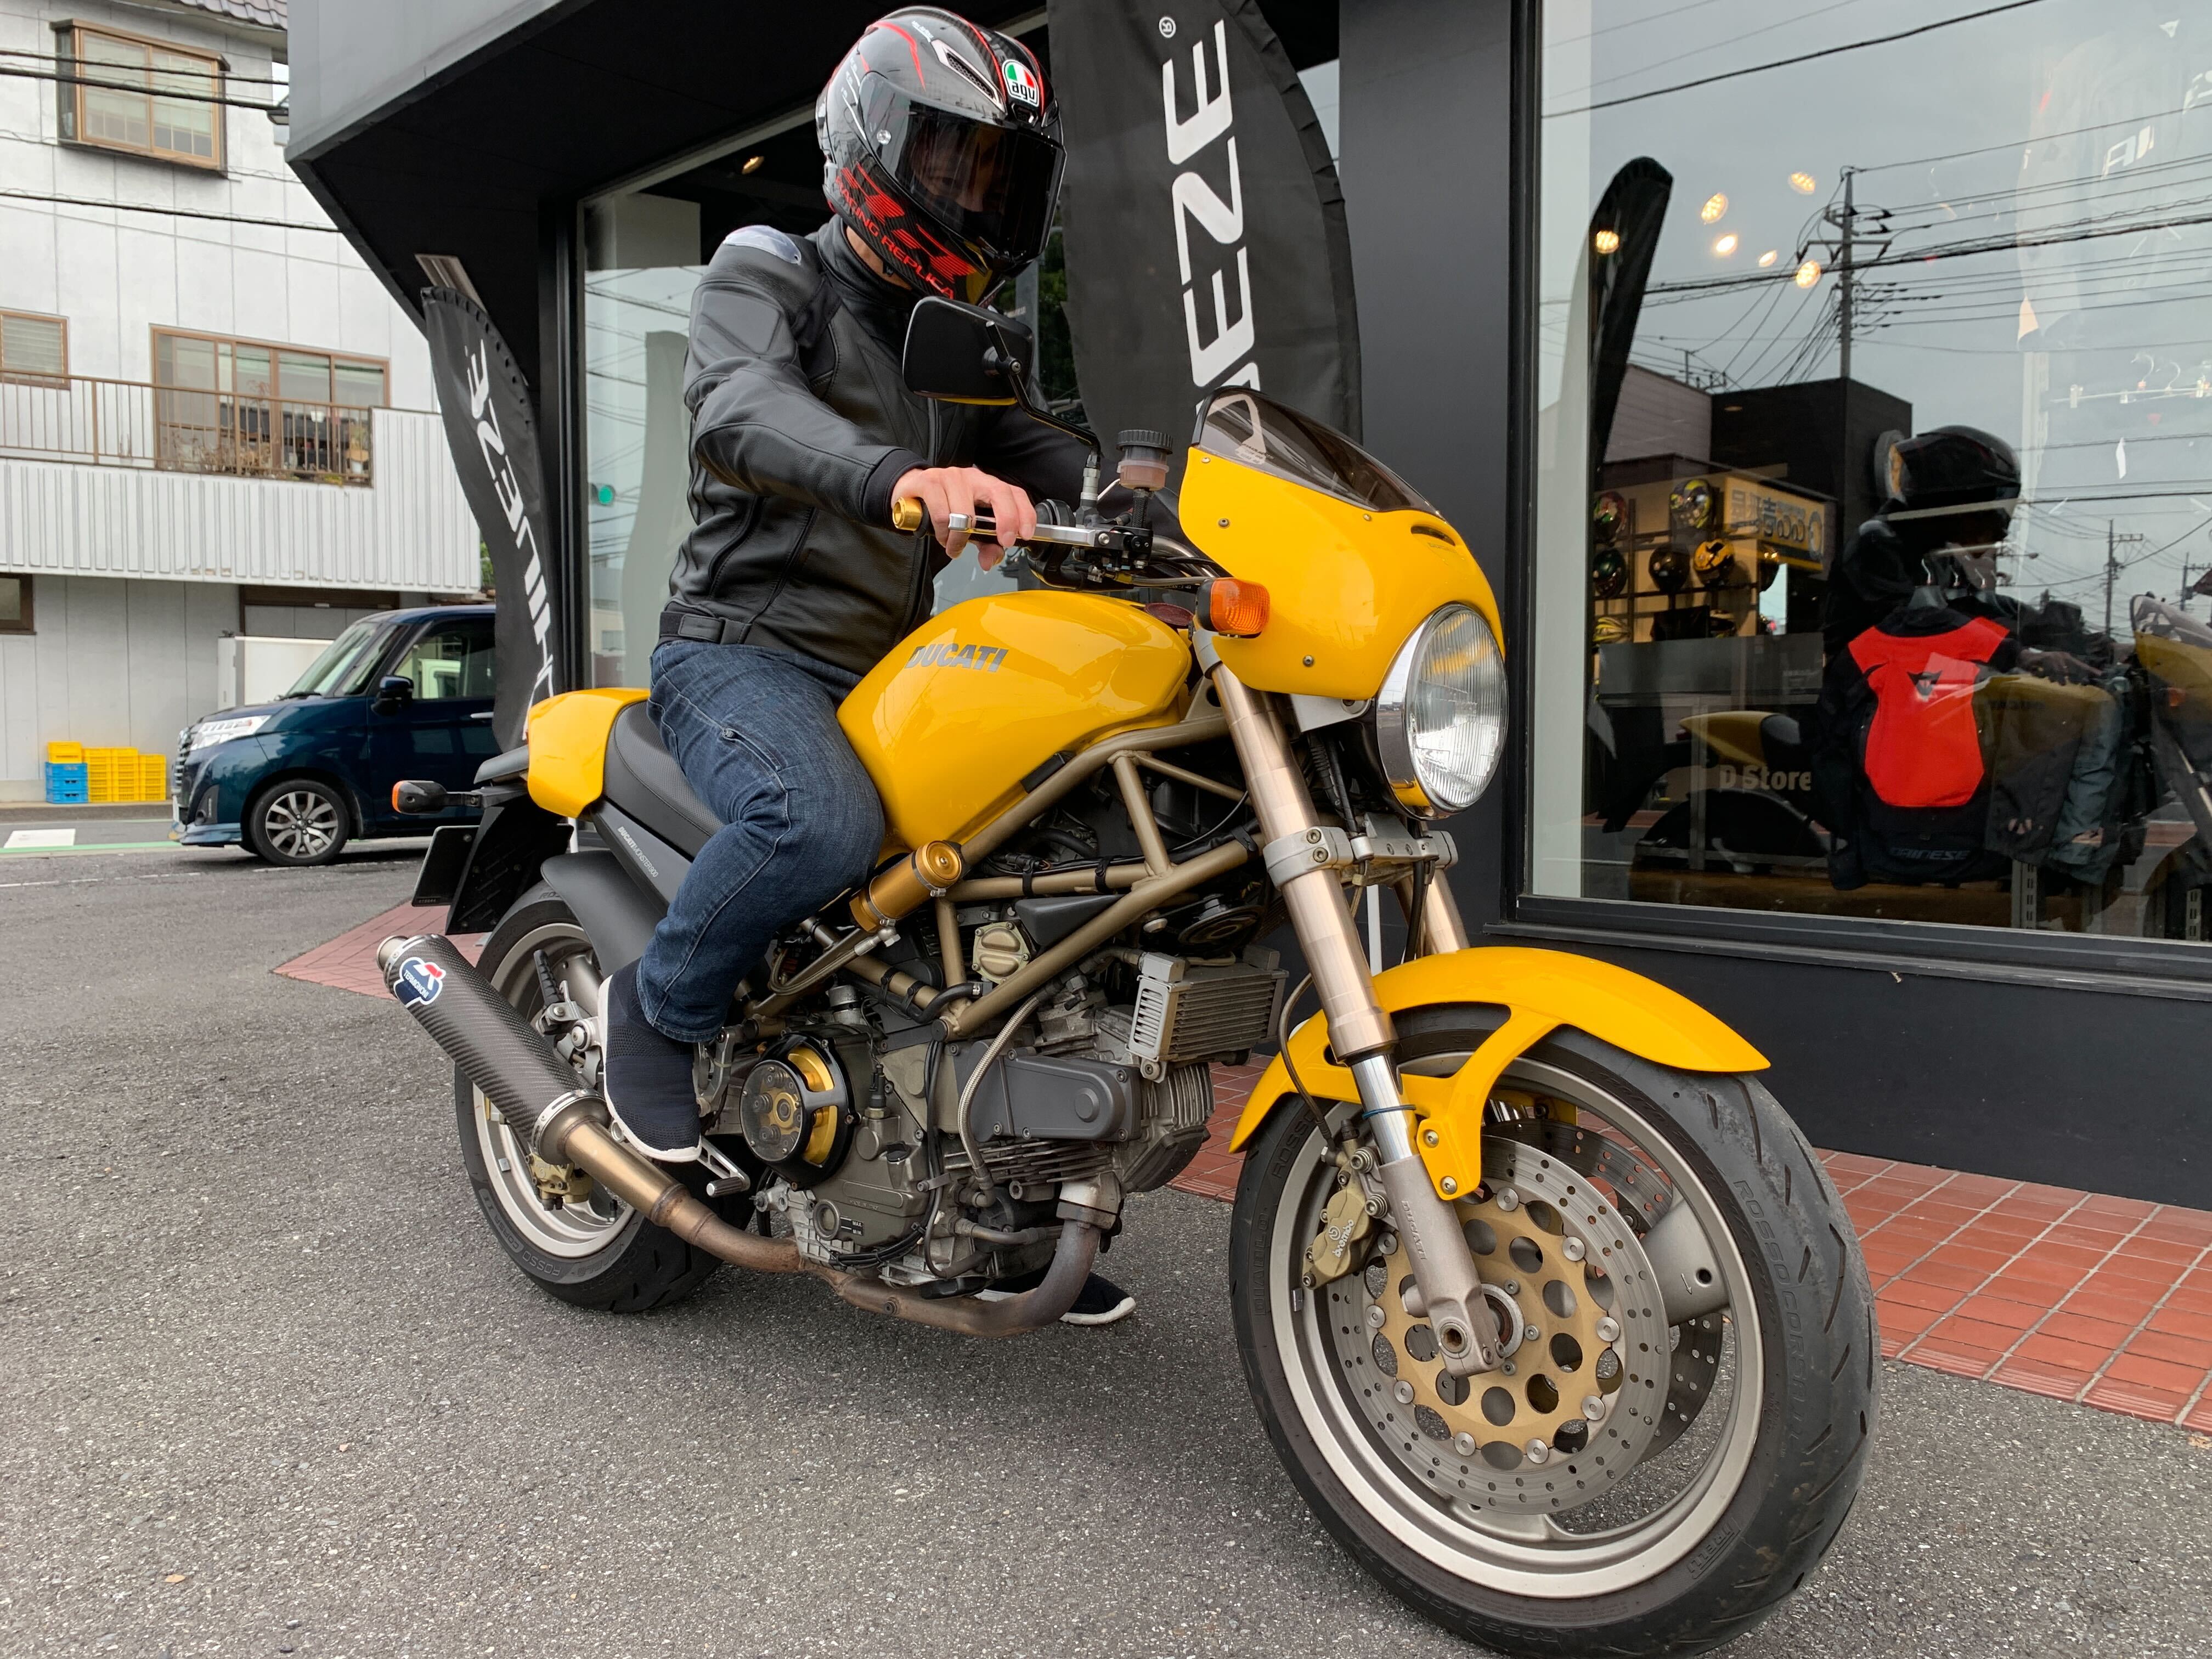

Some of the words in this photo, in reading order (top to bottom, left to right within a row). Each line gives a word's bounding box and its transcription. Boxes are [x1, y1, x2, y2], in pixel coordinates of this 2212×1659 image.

[1012, 81, 1035, 100] agv
[905, 642, 1009, 673] DUCATI
[1720, 766, 1736, 788] D
[1742, 765, 1812, 791] Store
[1332, 1219, 1355, 1259] brembo
[1401, 1200, 1427, 1260] DUCATI
[1733, 1180, 1790, 1285] ROSSO
[523, 1251, 562, 1277] ROSSO
